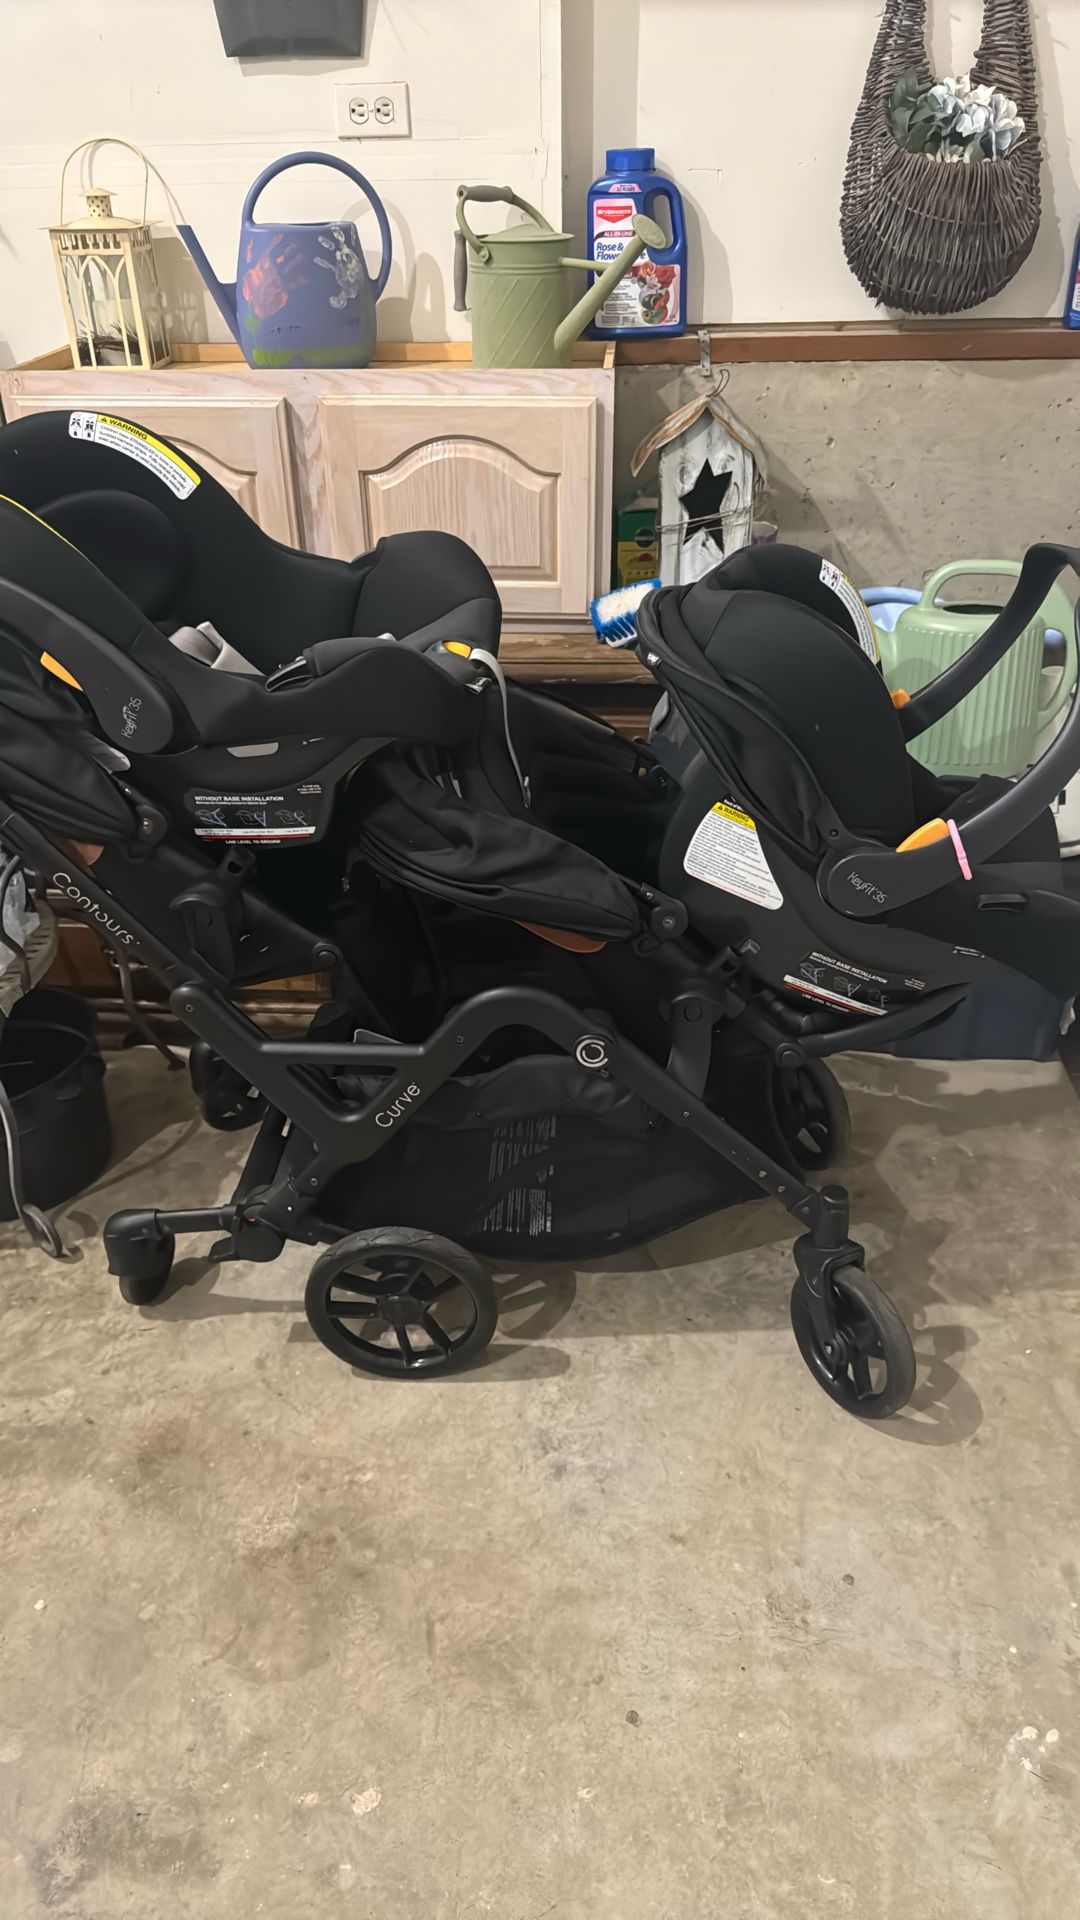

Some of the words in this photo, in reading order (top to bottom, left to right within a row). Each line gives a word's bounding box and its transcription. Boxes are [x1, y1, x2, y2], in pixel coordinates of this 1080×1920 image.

[596, 242, 617, 252] Rose
[617, 242, 624, 251] &
[596, 251, 621, 261] Flow
[109, 418, 148, 441] WARNING
[128, 696, 142, 711] 35
[121, 708, 138, 739] KeyFit
[723, 806, 749, 823] WARNING
[847, 872, 875, 896] KeyFit
[872, 890, 888, 903] 35
[53, 872, 134, 944] Contours
[811, 951, 836, 964] WITHOUT
[835, 961, 850, 970] BASE
[850, 967, 888, 983] INSTALLATION
[375, 1085, 420, 1128] Curve
